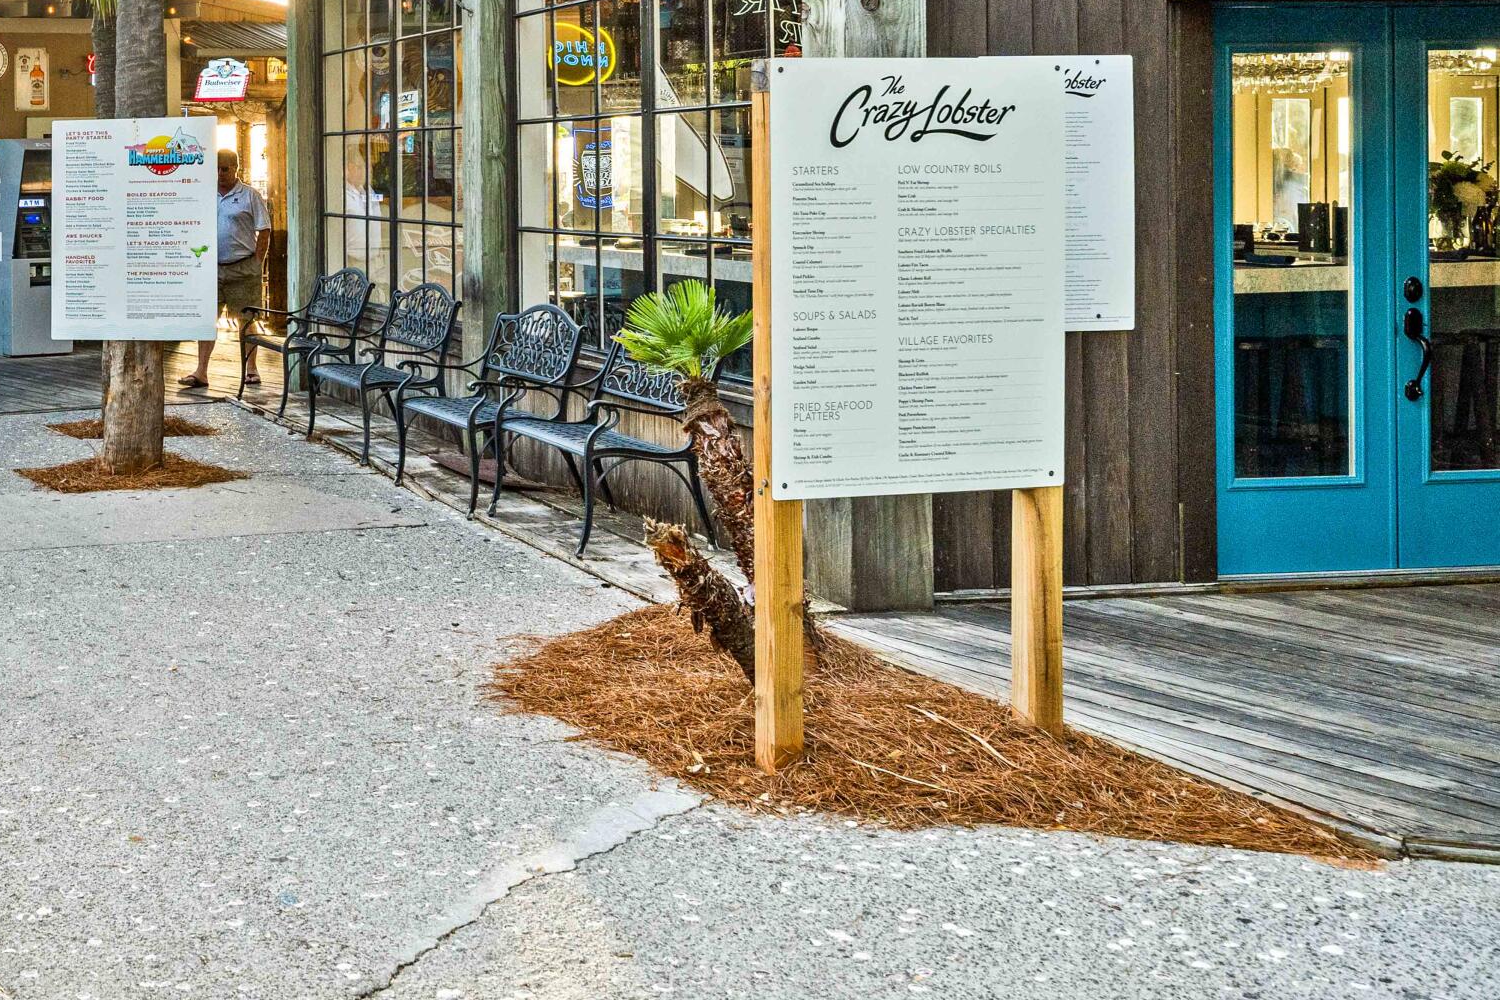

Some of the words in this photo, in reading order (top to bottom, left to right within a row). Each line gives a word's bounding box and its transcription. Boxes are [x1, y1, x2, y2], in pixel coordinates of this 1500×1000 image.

[204, 79, 242, 87] Budweiser
[881, 75, 906, 97] The
[830, 85, 917, 148] Crazy
[910, 85, 1016, 142] Lobster
[129, 150, 204, 166] HAMMERHEAD'S
[792, 166, 839, 175] STARTERS
[898, 165, 920, 174] LOW
[924, 164, 970, 174] COUNTRY
[974, 164, 1002, 173] BOILS
[898, 226, 931, 236] CRAZY
[934, 226, 976, 236] LOBSTER
[980, 225, 1036, 235] SPECIALTIES
[793, 311, 825, 321] SOUPS
[828, 310, 835, 320] &
[839, 310, 877, 320] SALADS
[898, 335, 939, 345] VILLAGE
[942, 334, 993, 344] FAVORITES
[793, 402, 822, 411] FRIED
[824, 400, 873, 411] SEAFOOD
[793, 411, 840, 421] PLATTERS
